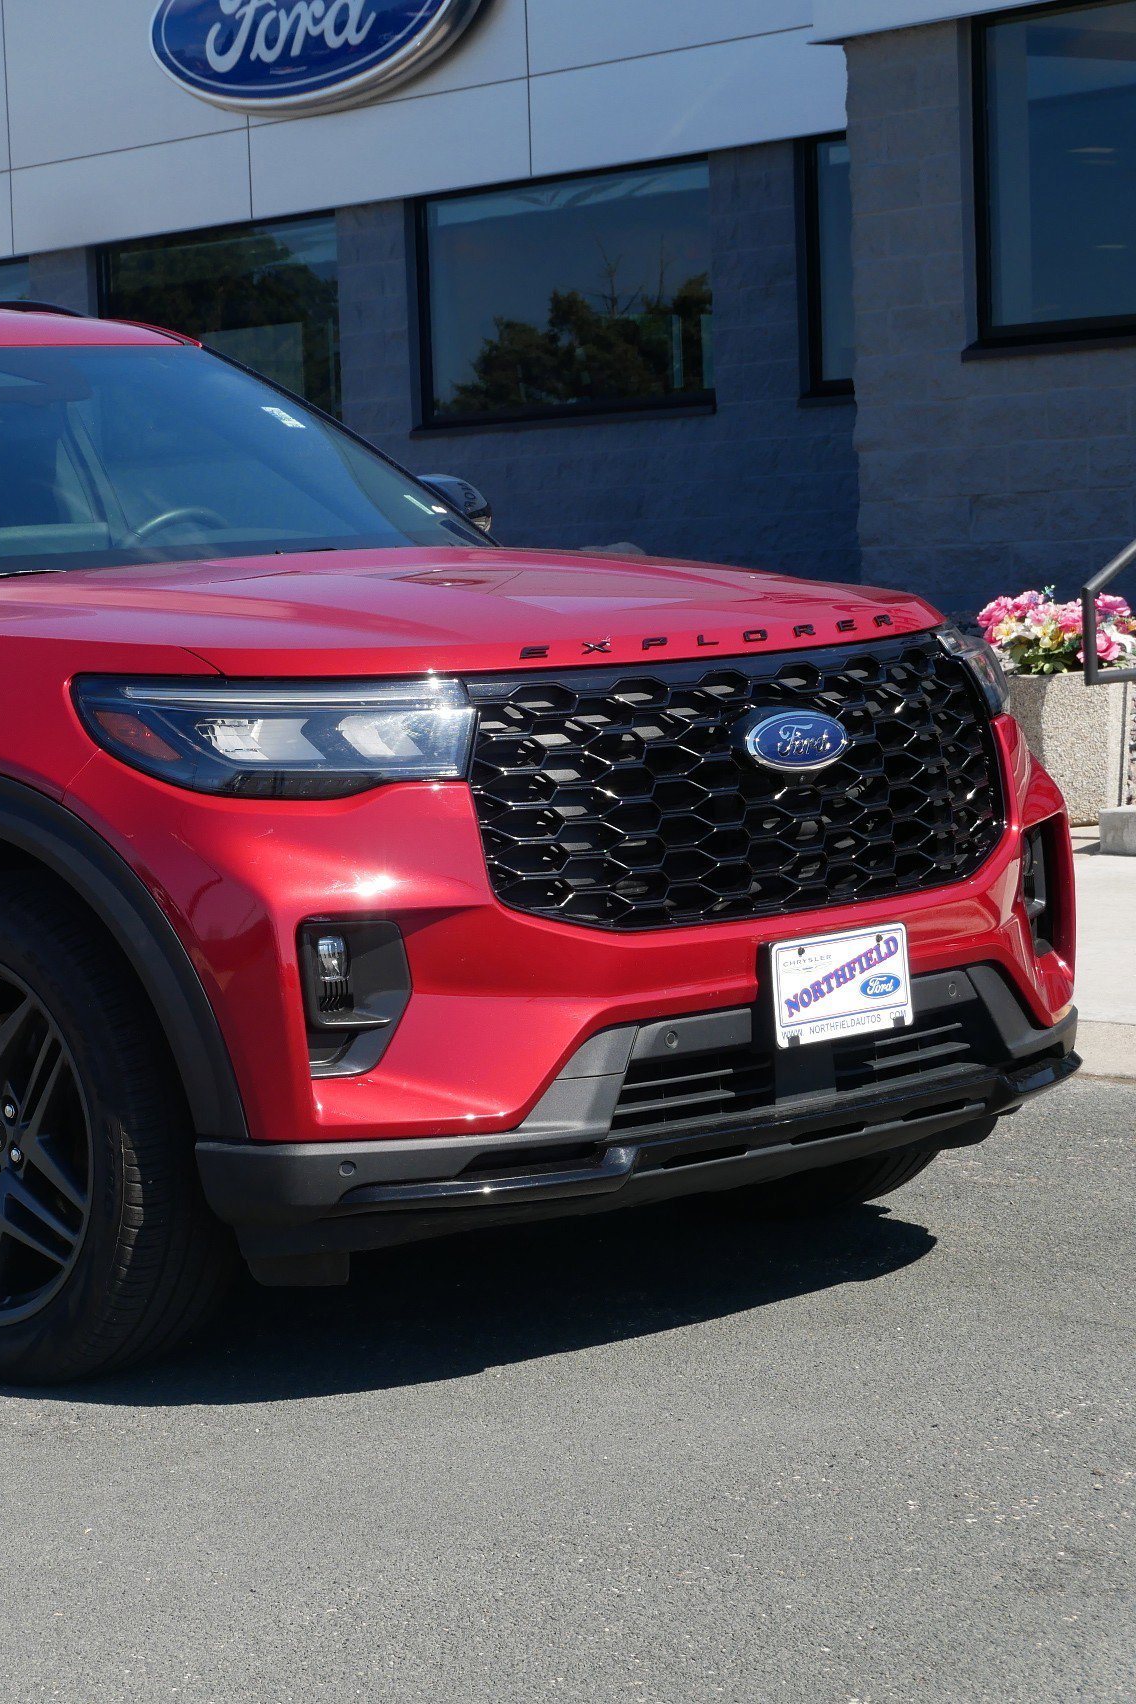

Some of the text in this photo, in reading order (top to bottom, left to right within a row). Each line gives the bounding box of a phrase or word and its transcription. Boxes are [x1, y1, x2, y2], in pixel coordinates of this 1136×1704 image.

[520, 614, 894, 659] EXPLORER
[778, 723, 831, 757] Ford
[782, 955, 832, 967] CHRYSLER
[784, 935, 899, 1018] NORTHFIELD
[867, 976, 894, 994] Ford
